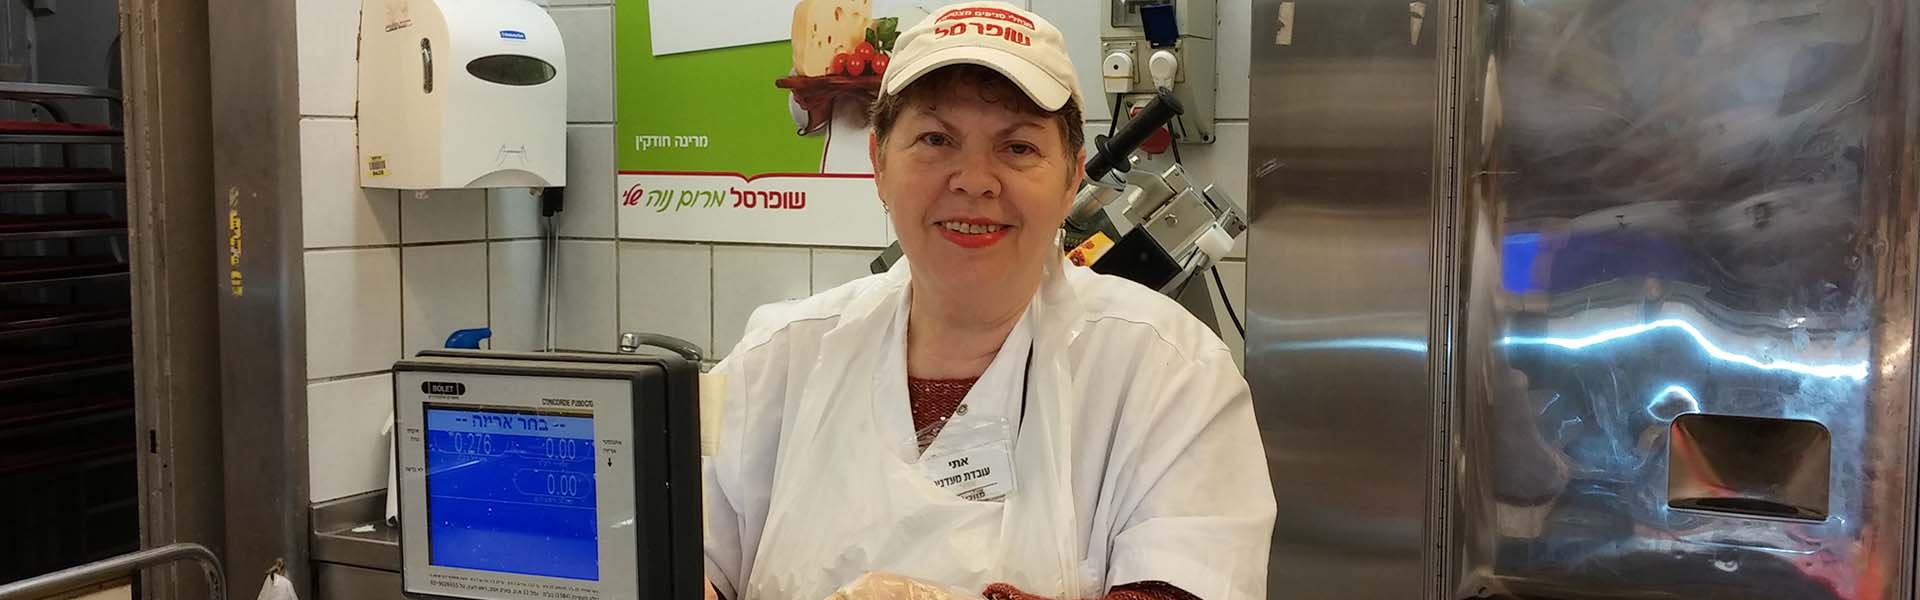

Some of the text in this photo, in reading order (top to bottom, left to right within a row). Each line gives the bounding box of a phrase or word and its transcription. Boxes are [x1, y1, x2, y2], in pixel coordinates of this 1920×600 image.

[934, 22, 1031, 46] שופרסל
[635, 135, 709, 150] מרינה חודקין
[646, 189, 674, 213] נוה
[675, 190, 726, 211] מרום
[730, 187, 806, 210] שופרסל
[472, 415, 513, 429] אריזה
[517, 417, 549, 431] בחר
[546, 438, 576, 460] 0.00
[948, 457, 969, 469] אתי
[547, 474, 577, 496] 0.00
[963, 467, 990, 482] עובדת
